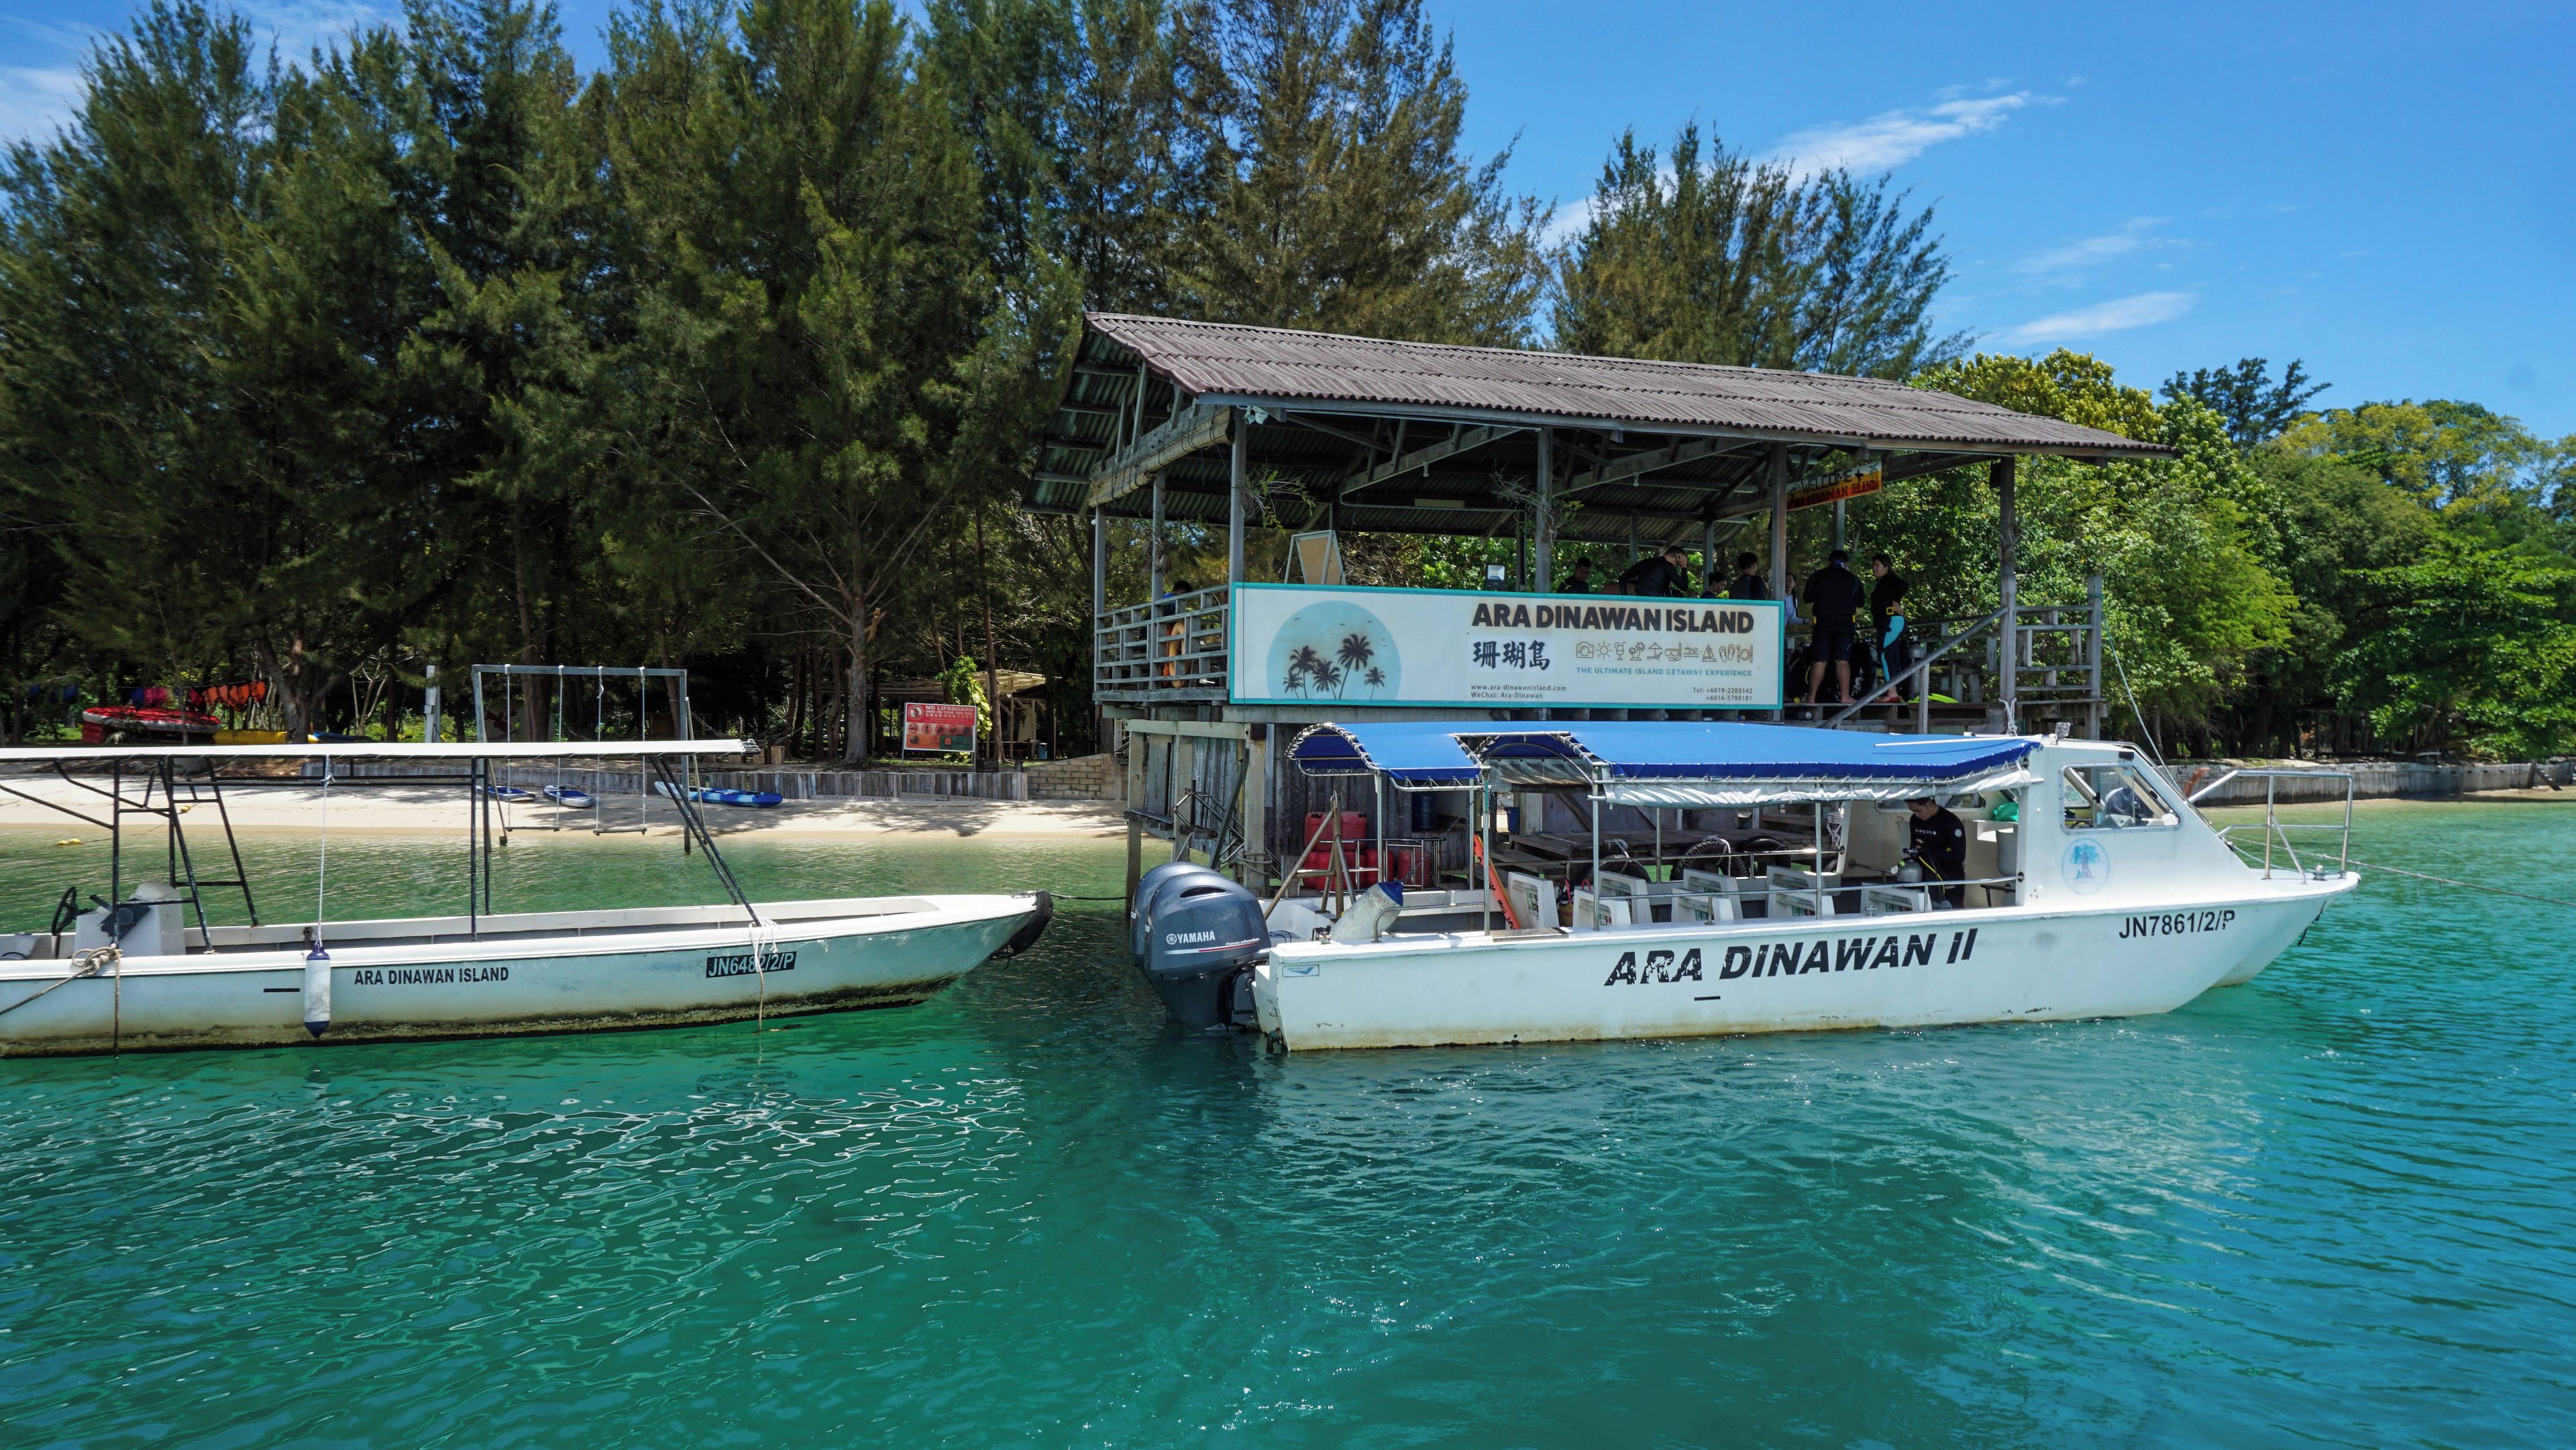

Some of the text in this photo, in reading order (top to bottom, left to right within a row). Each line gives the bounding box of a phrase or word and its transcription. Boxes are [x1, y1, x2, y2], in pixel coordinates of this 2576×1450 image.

[1801, 470, 1852, 493] WELCOME
[1472, 603, 1754, 633] ARA DINAWAN ISLAND
[1472, 639, 1550, 670] 珊瑚島
[1177, 931, 1216, 943] YAMAHA
[2118, 910, 2235, 938] JN7861/2/P
[1603, 929, 1978, 986] ARA DINAWAN II
[354, 967, 509, 985] ARA DINAWAN ISLAND
